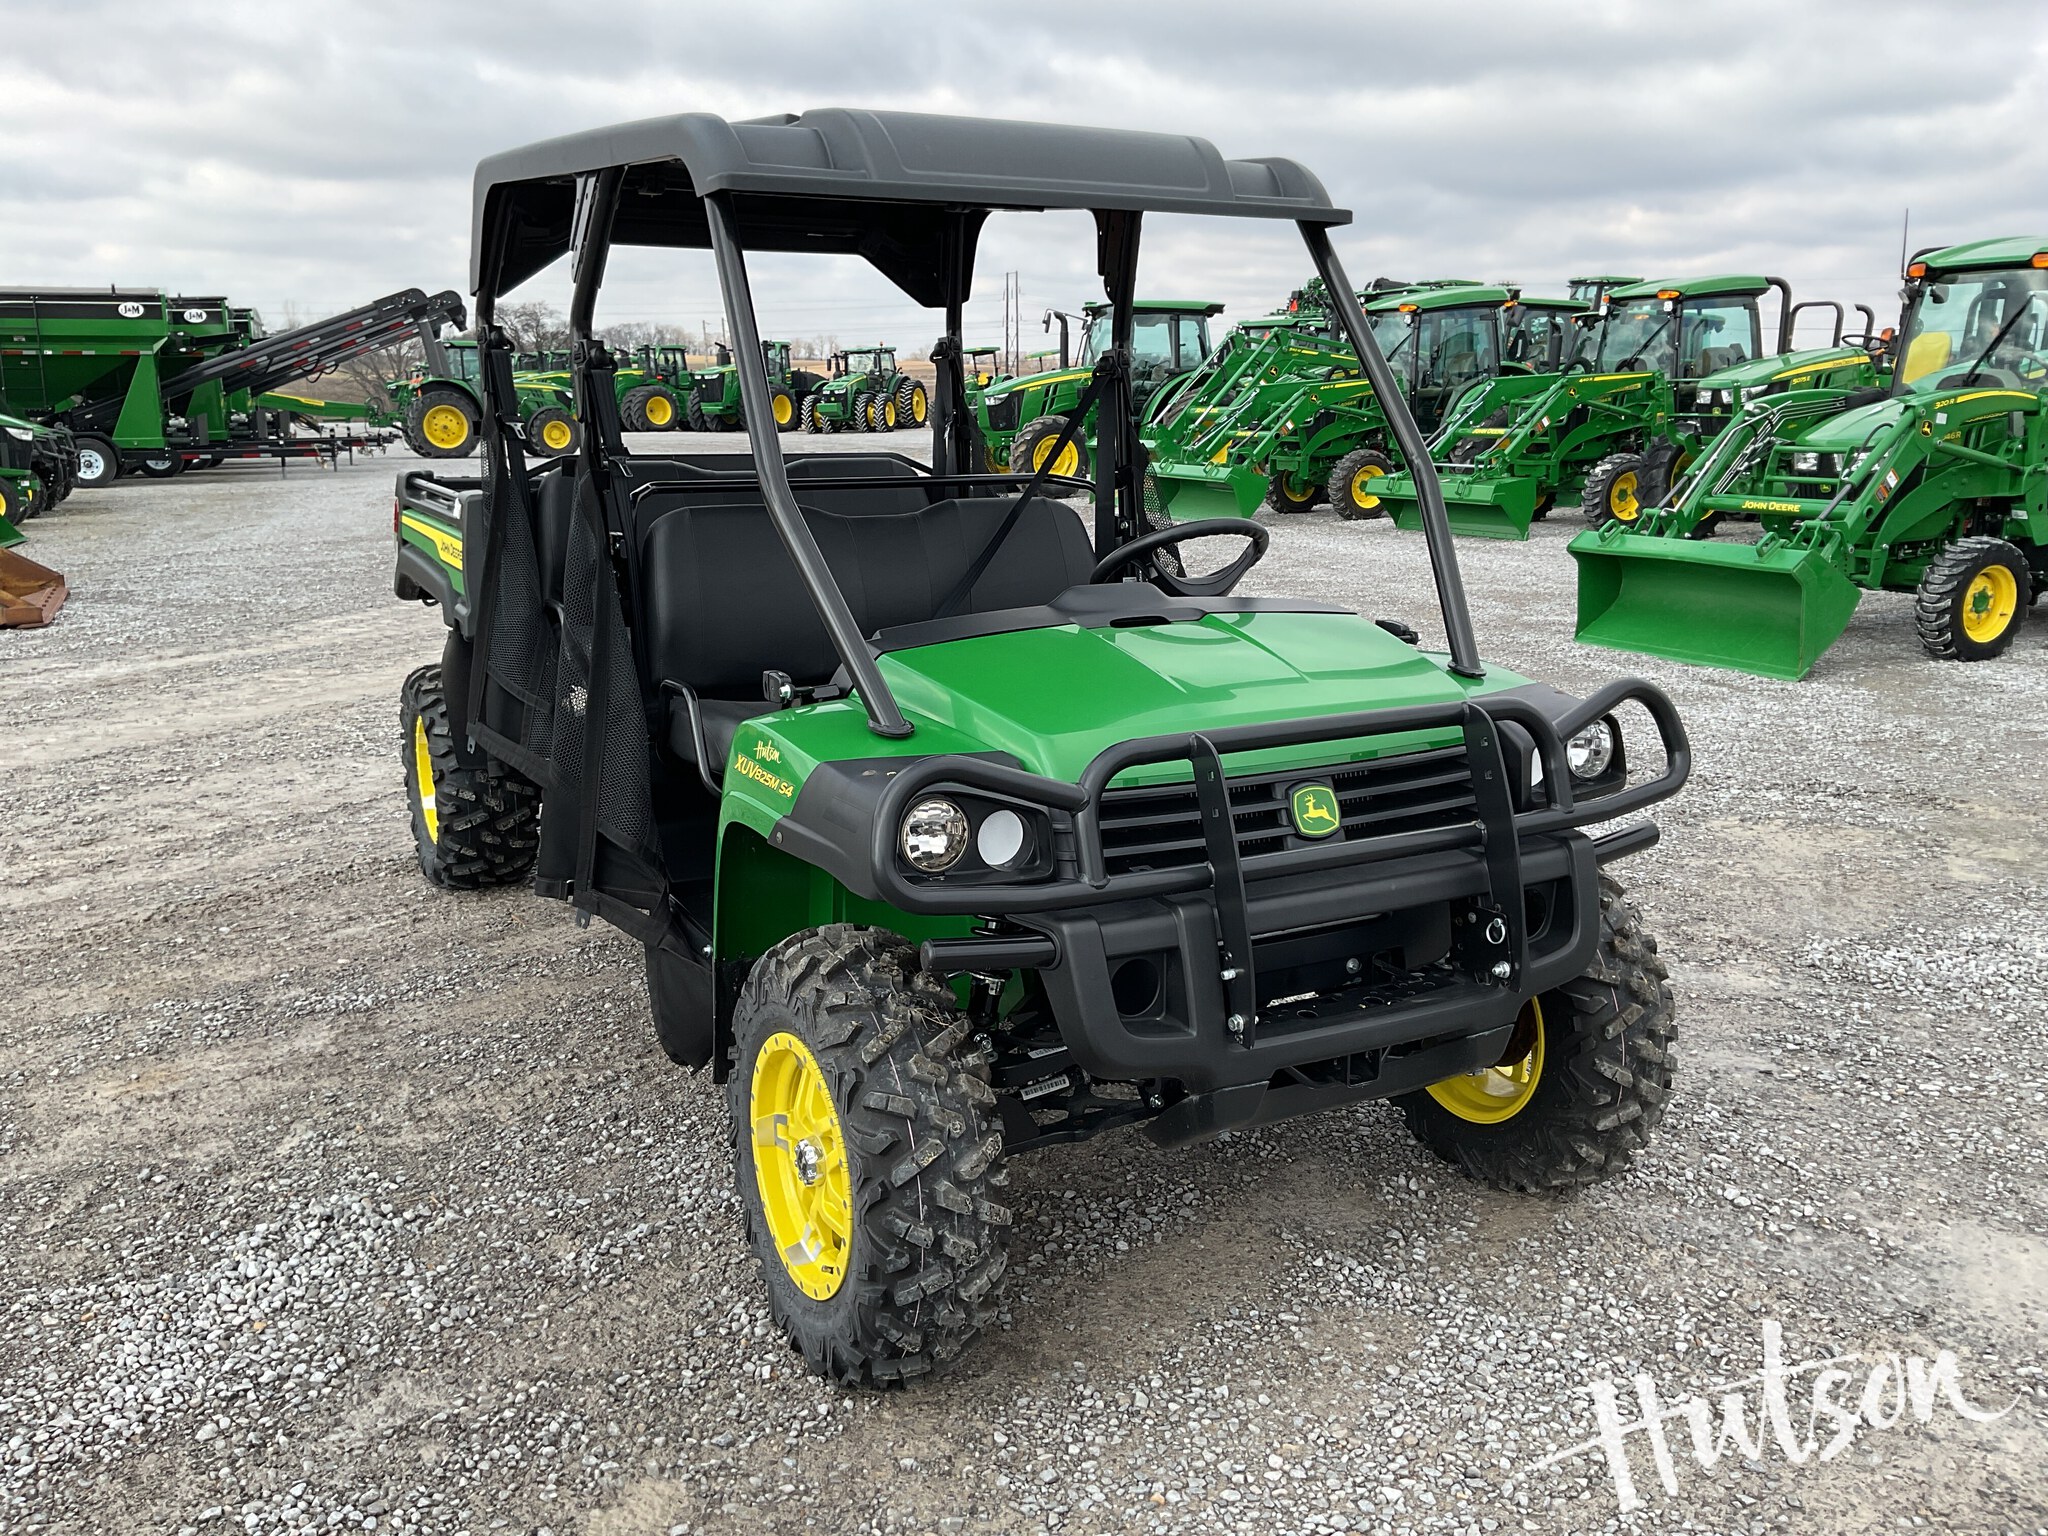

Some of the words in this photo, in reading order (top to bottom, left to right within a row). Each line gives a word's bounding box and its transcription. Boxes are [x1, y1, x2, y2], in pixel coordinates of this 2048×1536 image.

[123, 305, 140, 315] J&M
[188, 311, 203, 320] J&M
[1741, 500, 1767, 510] JOHN
[1768, 501, 1801, 512] DEERE
[753, 740, 782, 764] Hutson
[734, 753, 781, 791] XUV825M
[778, 782, 794, 798] S4
